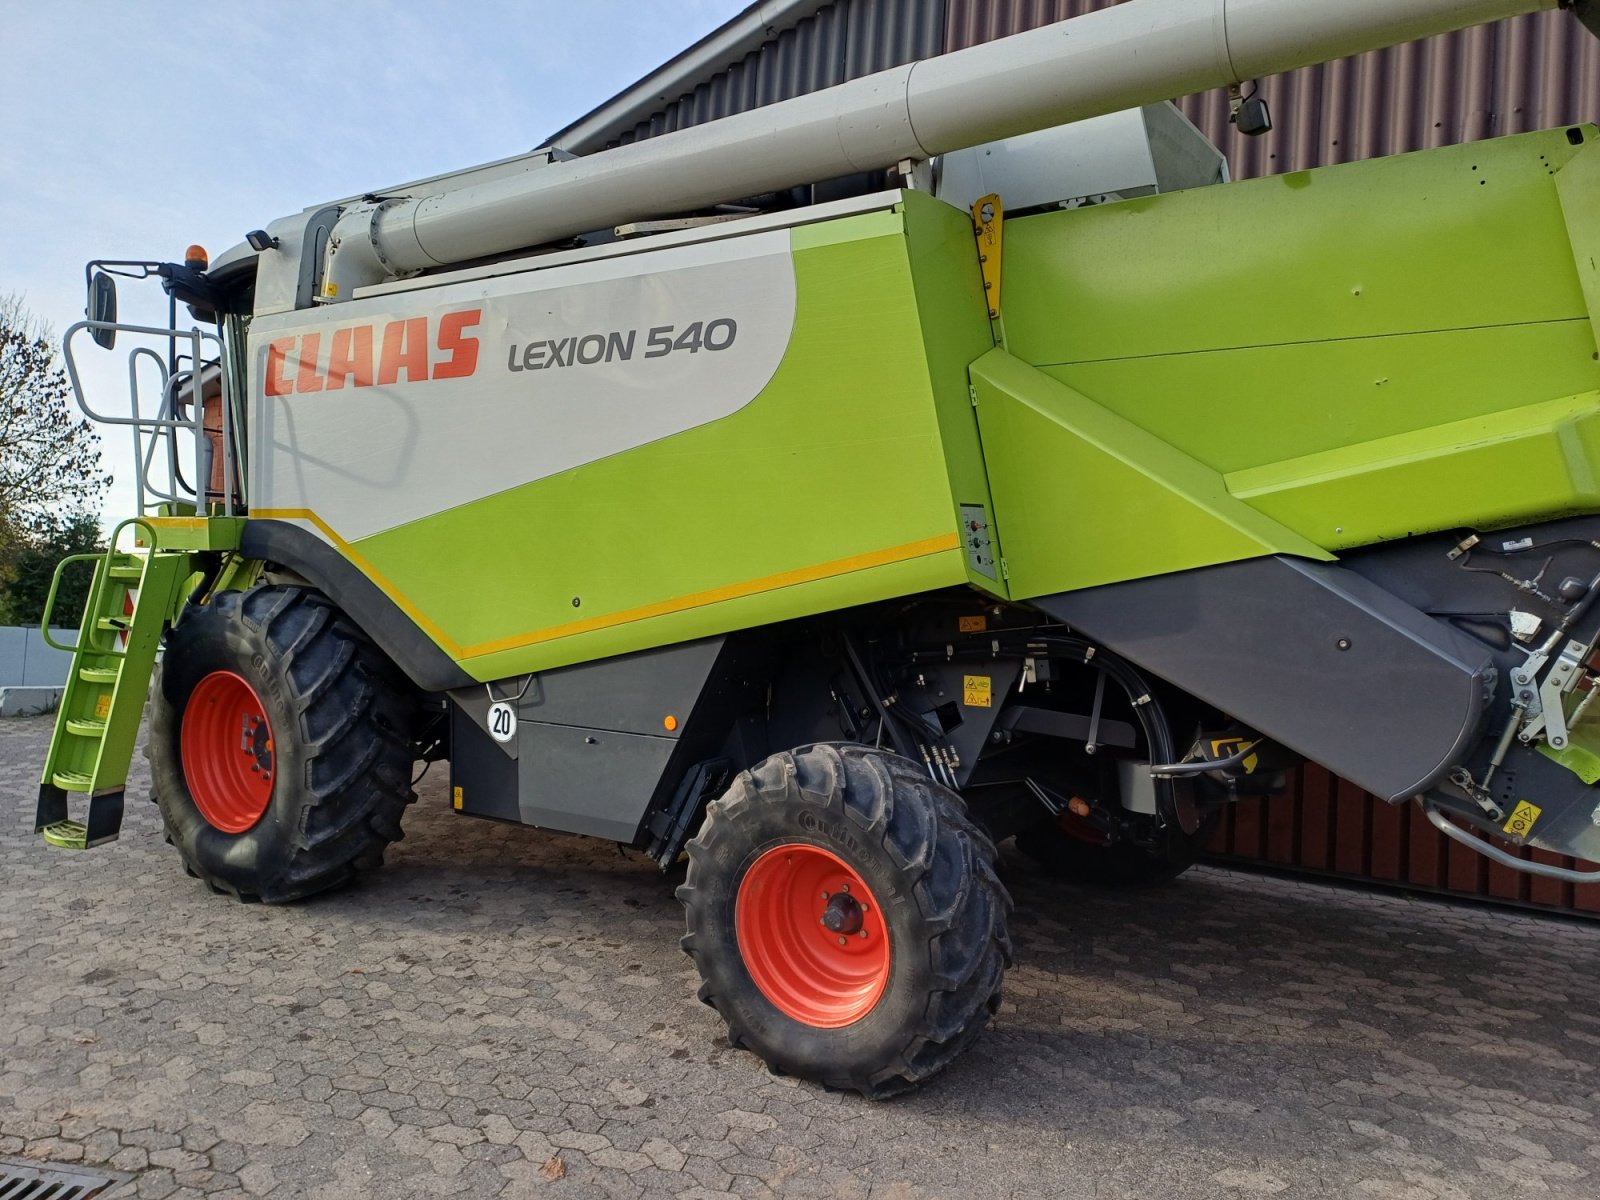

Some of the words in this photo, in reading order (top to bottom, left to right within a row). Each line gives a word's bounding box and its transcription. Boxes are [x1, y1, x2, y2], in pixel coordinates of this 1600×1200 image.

[265, 309, 482, 396] CLAAS
[508, 330, 636, 372] LEXION
[645, 318, 737, 358] 540
[493, 707, 511, 735] 20
